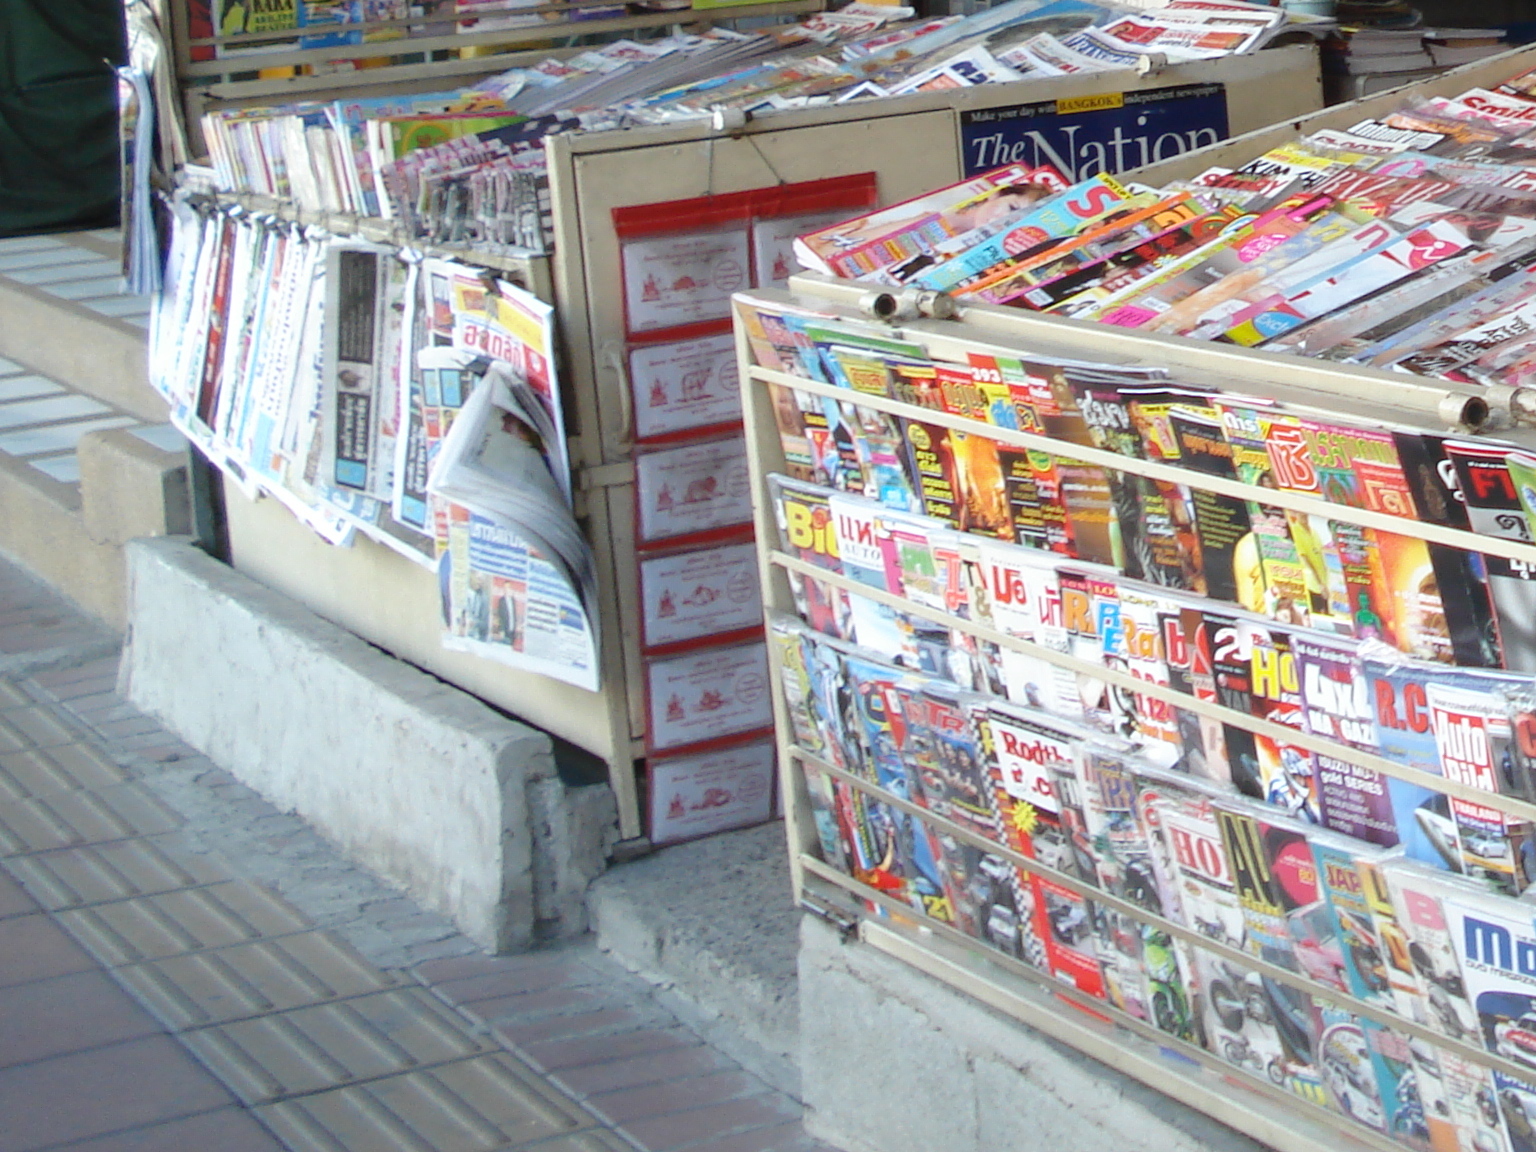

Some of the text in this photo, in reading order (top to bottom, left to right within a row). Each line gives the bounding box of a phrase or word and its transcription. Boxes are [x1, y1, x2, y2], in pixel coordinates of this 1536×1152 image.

[973, 114, 1217, 185] The Nation
[970, 366, 1001, 384] 393
